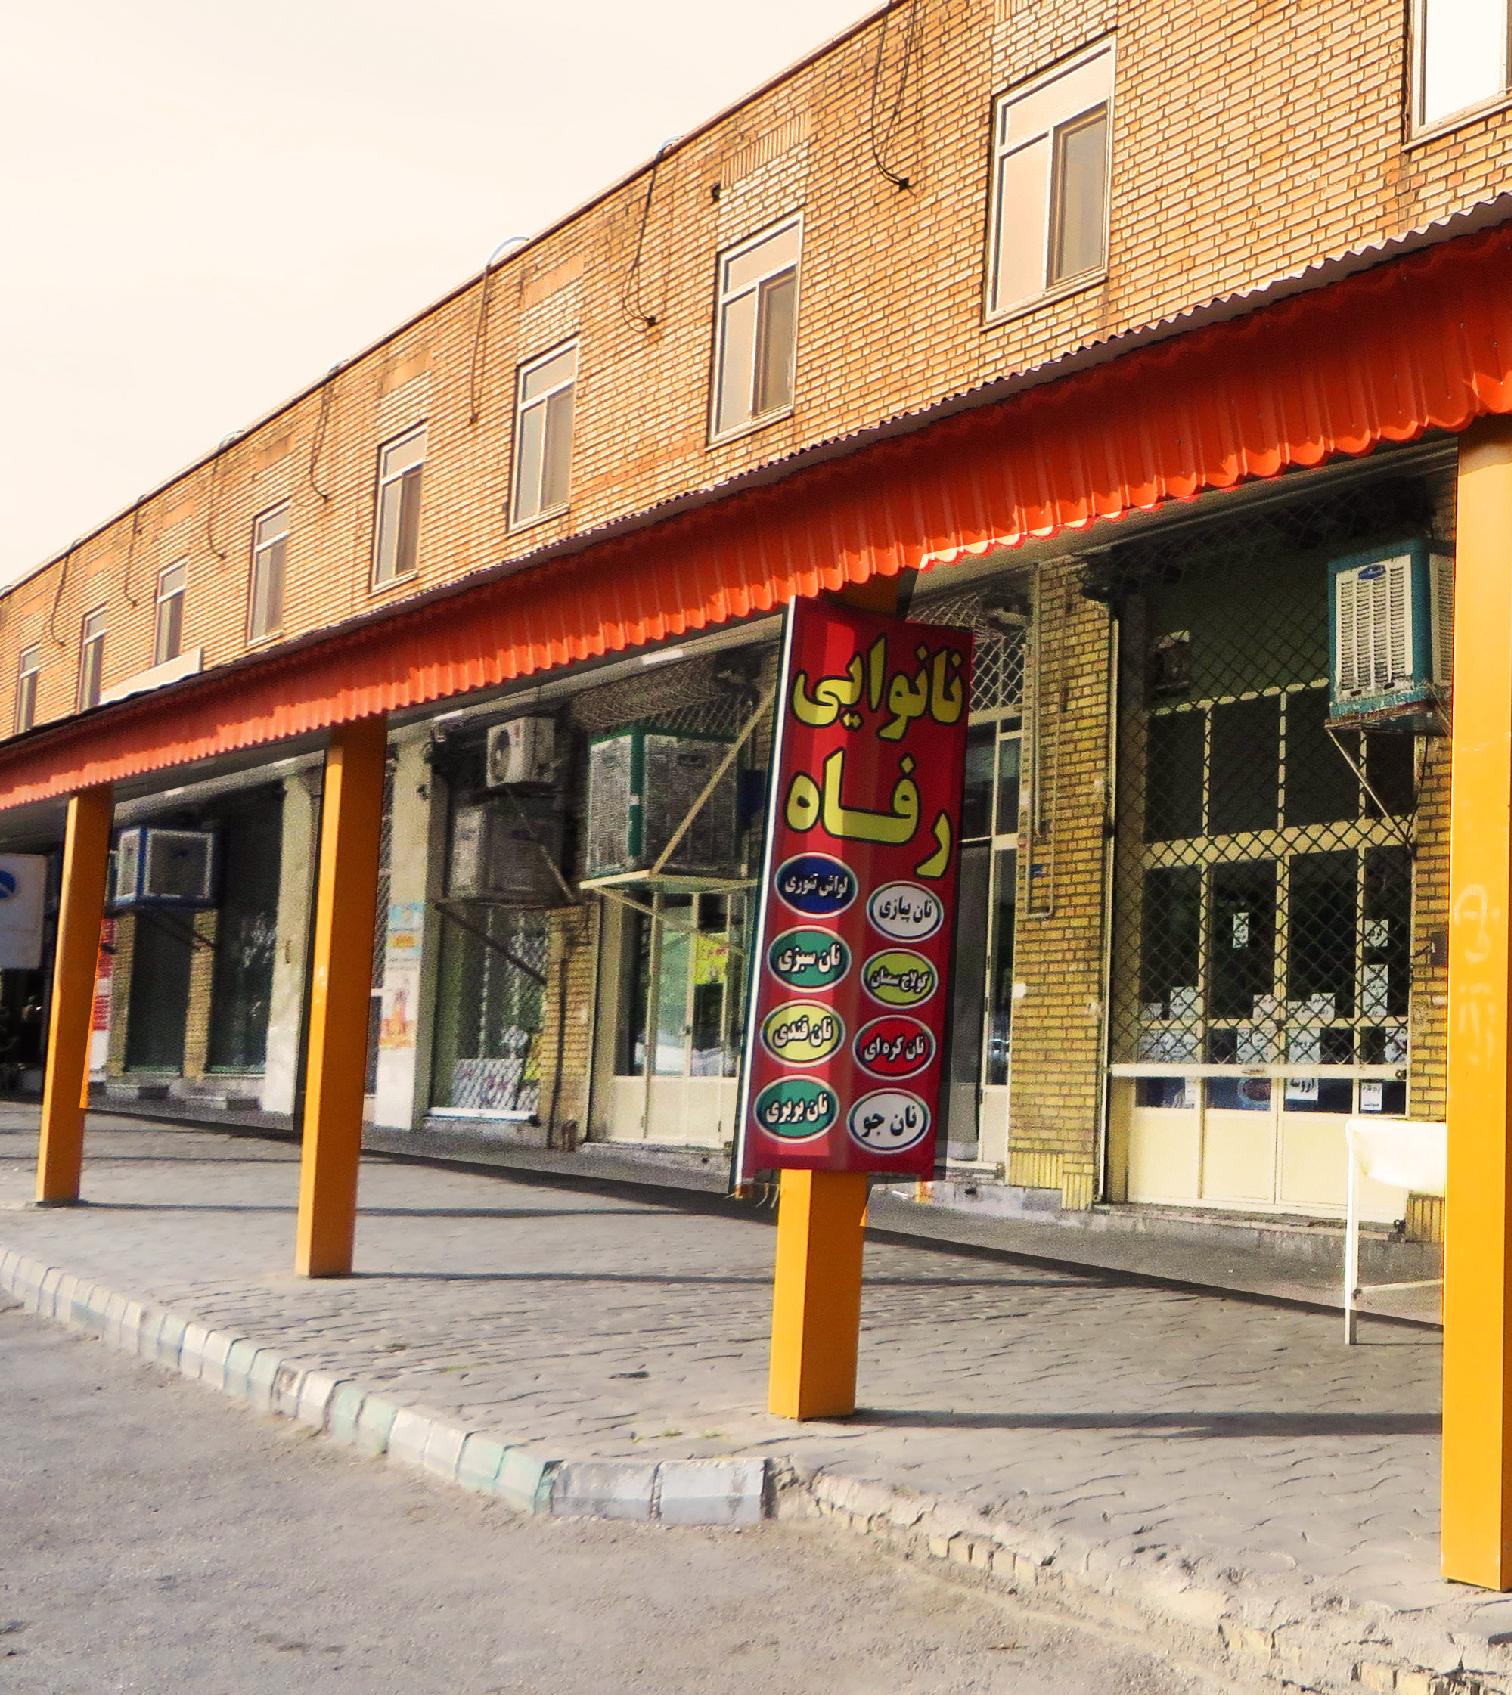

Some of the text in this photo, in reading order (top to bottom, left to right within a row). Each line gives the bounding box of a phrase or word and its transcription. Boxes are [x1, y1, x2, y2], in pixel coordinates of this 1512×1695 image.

[790, 637, 966, 740] نانوایی
[784, 747, 953, 879] رفاه
[879, 895, 933, 924] نان پیازی
[778, 943, 842, 974] نان سبزی
[773, 1015, 833, 1047] نان قندی
[905, 1036, 925, 1061] نان
[766, 1092, 829, 1124] نان بربری
[861, 1104, 918, 1138] نان جو
